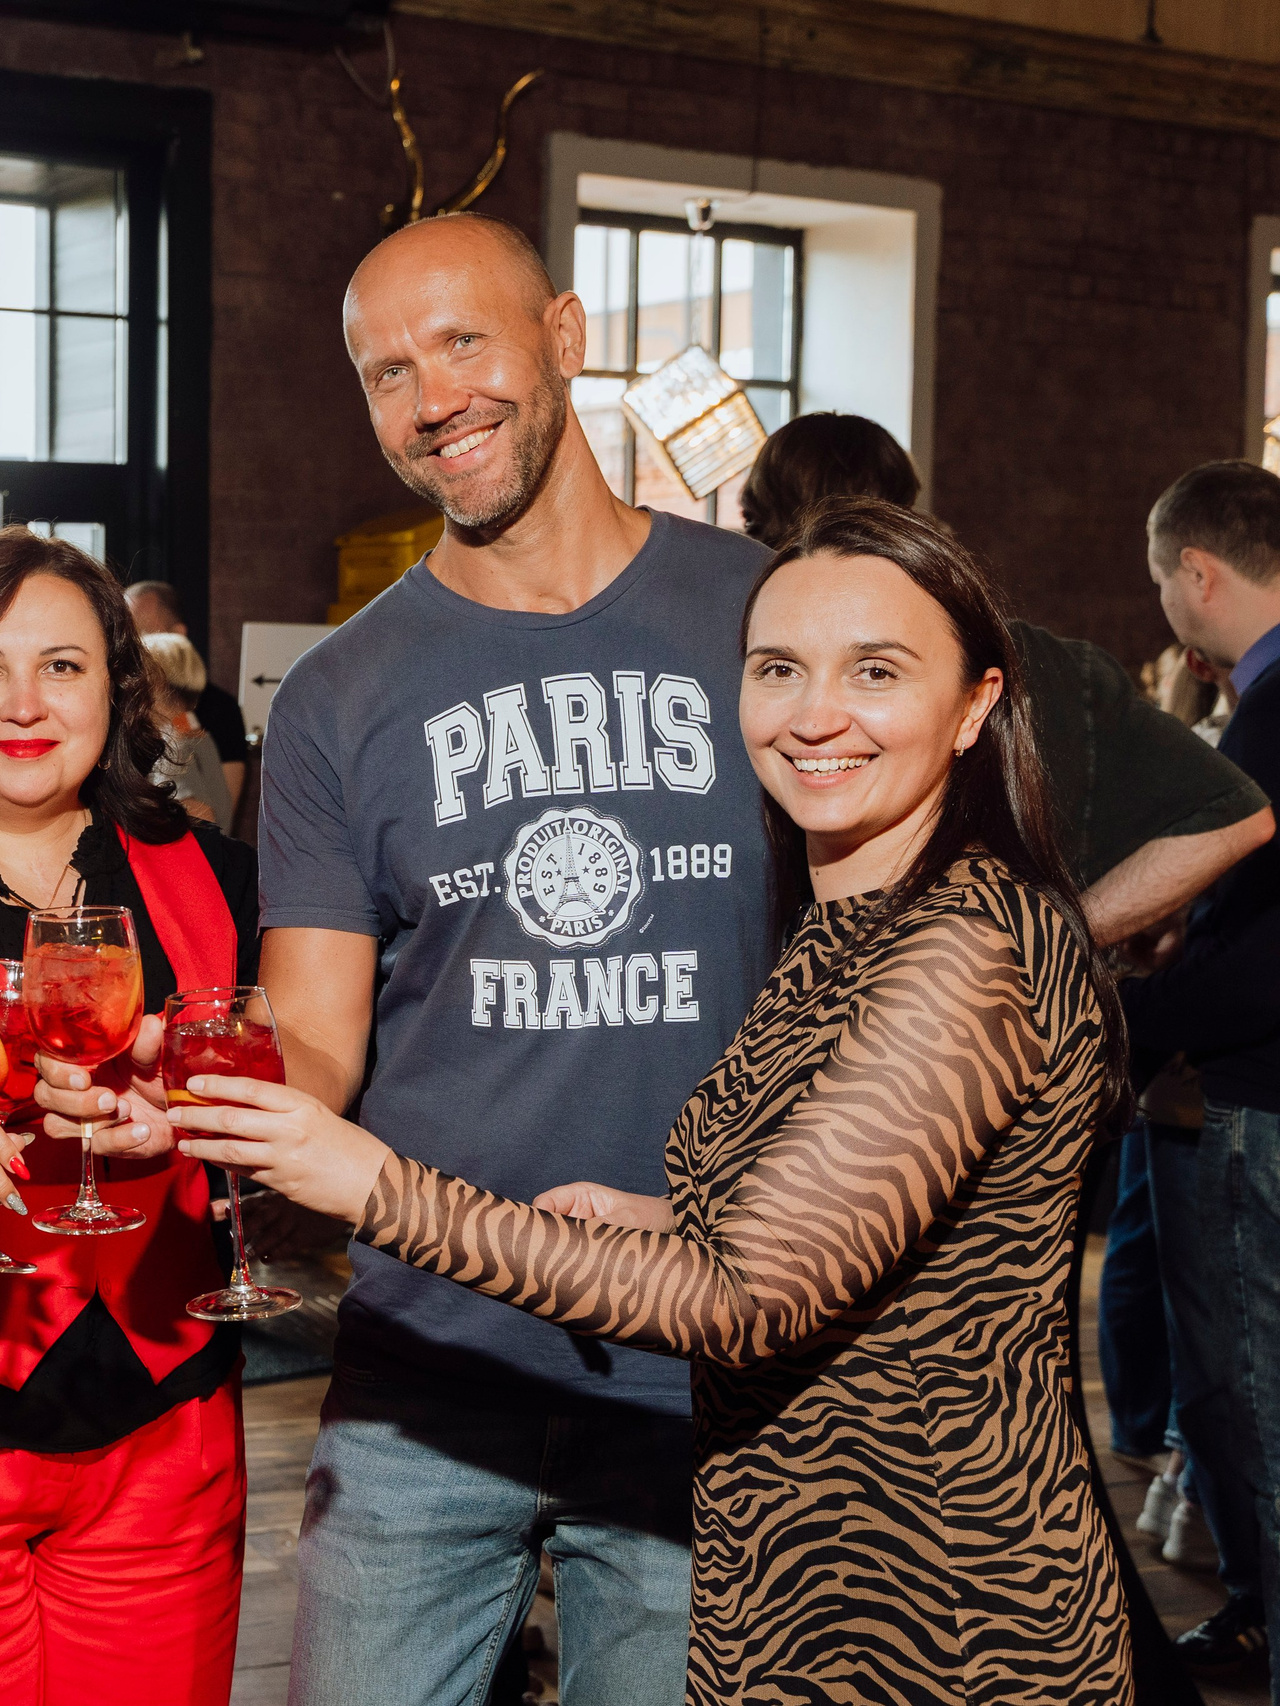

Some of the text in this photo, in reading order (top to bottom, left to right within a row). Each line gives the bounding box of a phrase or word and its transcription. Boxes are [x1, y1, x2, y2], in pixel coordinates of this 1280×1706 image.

[424, 670, 716, 827] PARIS
[429, 862, 502, 906] EST.
[517, 820, 630, 899] PRODUIT ORIGINAL
[650, 843, 733, 882] 1889
[550, 914, 604, 936] PARIS
[470, 950, 700, 1030] FRANCE
